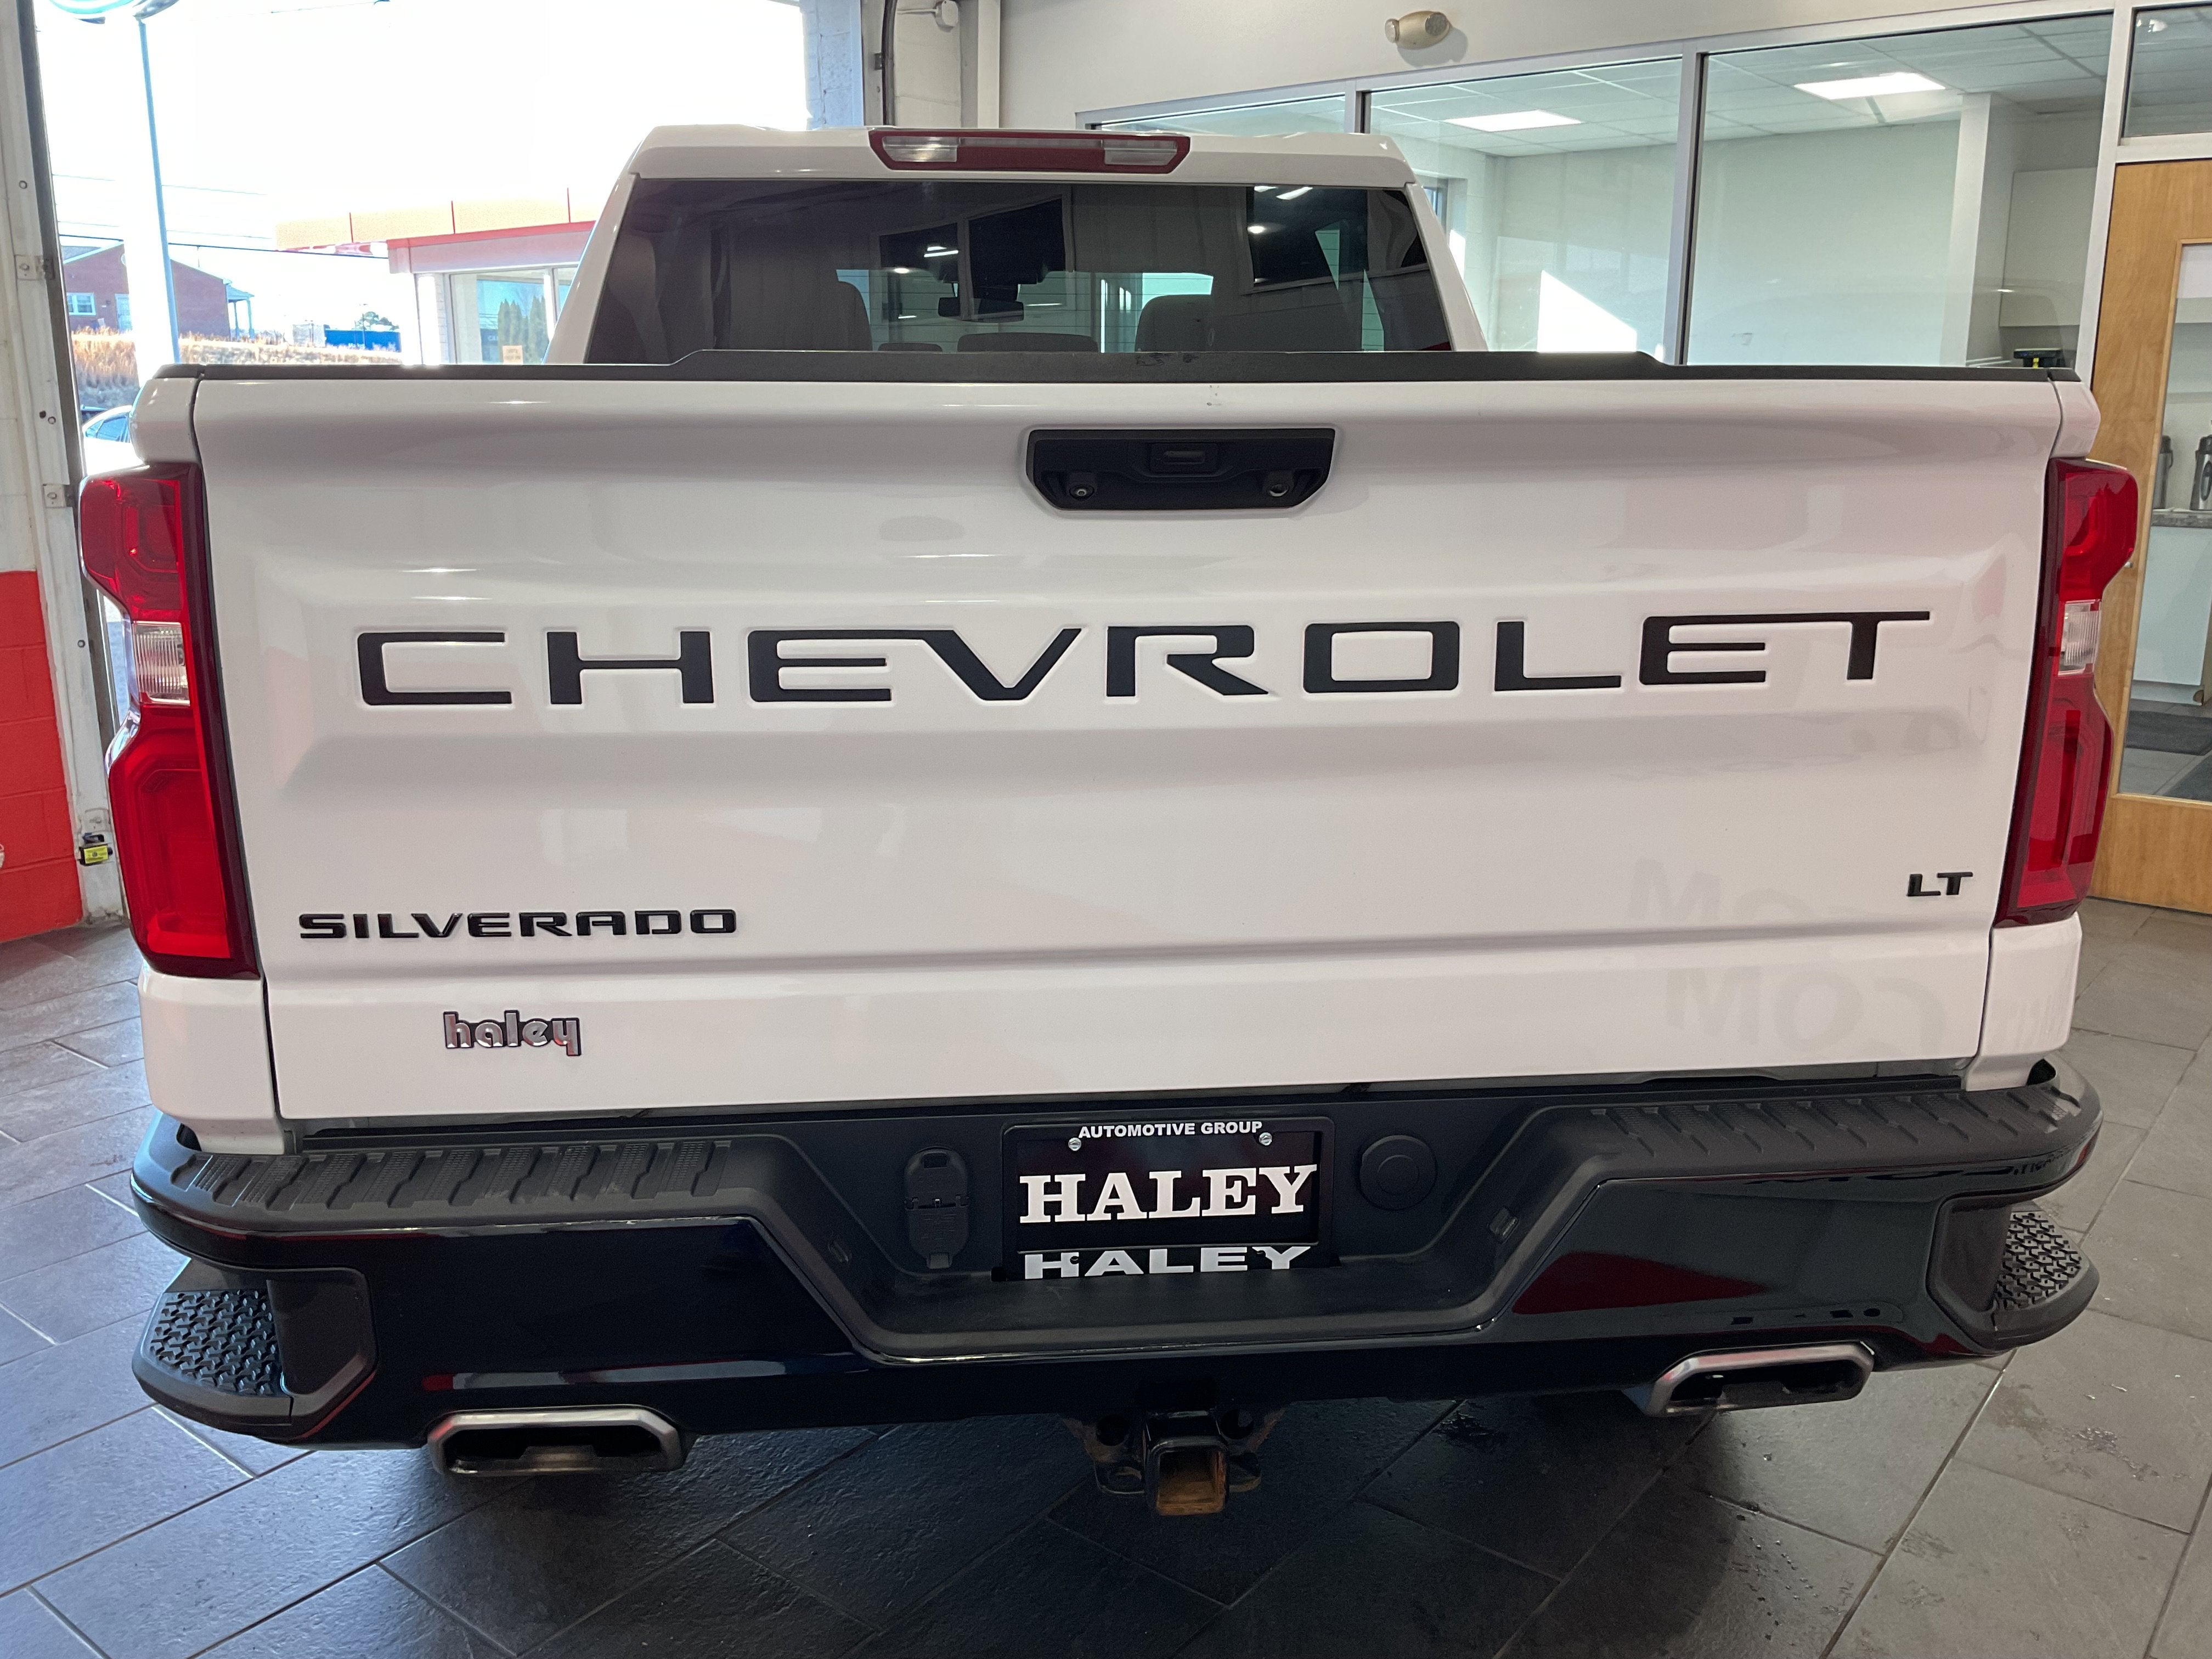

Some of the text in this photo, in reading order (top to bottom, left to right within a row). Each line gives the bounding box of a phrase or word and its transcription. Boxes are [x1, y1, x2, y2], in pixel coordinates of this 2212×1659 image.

[357, 610, 1931, 706] CHEVROLET
[1907, 871, 1974, 898] LT
[298, 909, 737, 939] SILVERADO
[443, 1009, 582, 1057] haley
[1078, 1120, 1263, 1139] AUTOMOTIVE GROUP
[1019, 1164, 1318, 1224] HALEY
[1024, 1246, 1312, 1280] HALEY
